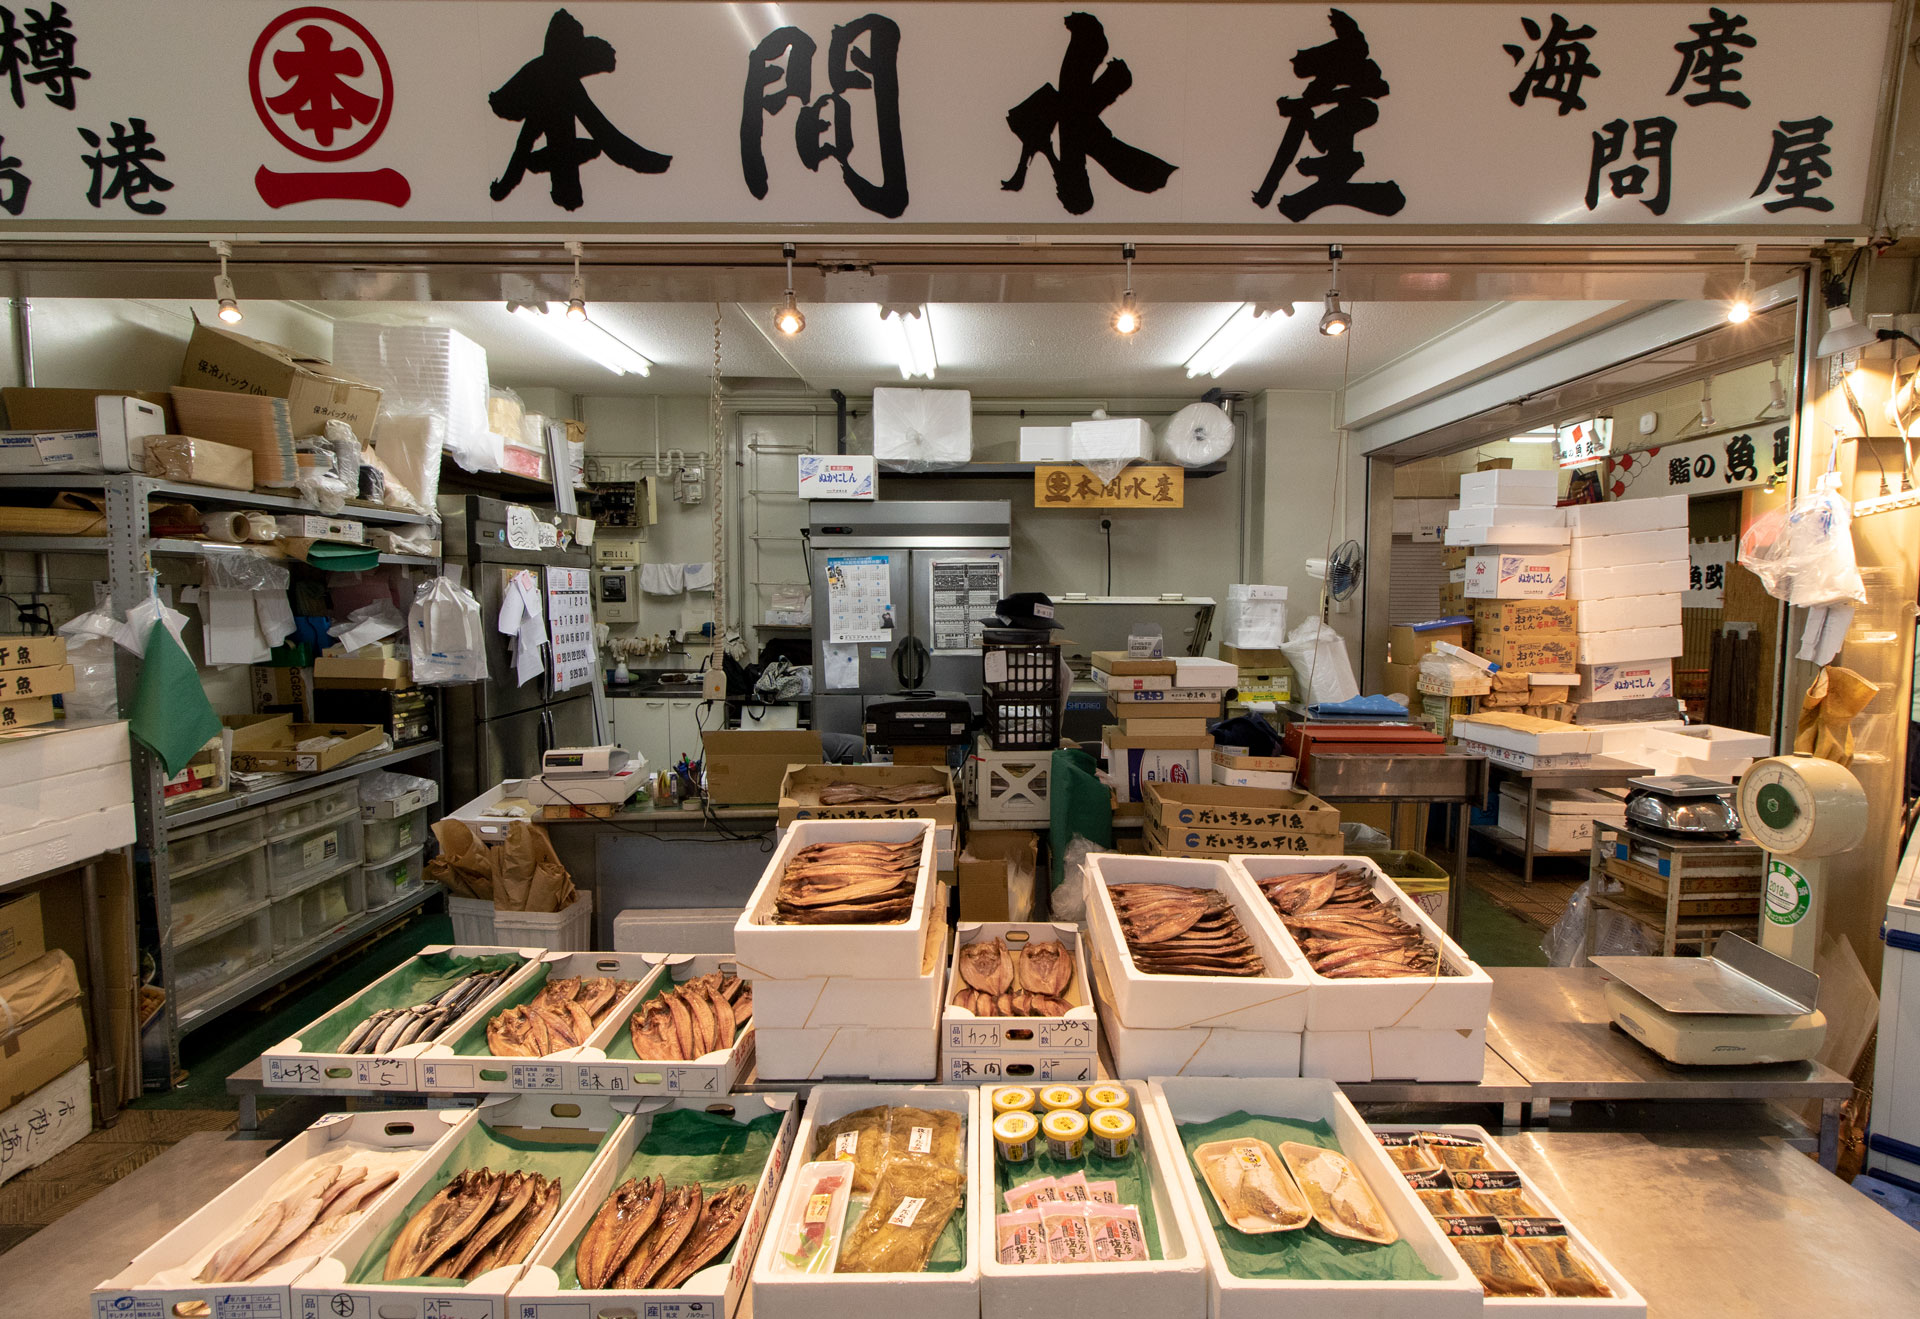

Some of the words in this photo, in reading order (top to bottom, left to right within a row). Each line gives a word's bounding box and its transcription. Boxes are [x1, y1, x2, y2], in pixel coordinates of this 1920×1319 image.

[488, 8, 1406, 222] 本間水産
[1585, 116, 1834, 215] 問屋
[818, 473, 857, 483] ぬかにしん
[1518, 573, 1553, 583] ぬかにしん
[1515, 613, 1543, 624] おから
[1515, 623, 1535, 631] にしん
[1517, 650, 1544, 661] おから
[1517, 660, 1536, 668] にしん
[1614, 677, 1655, 690] ぬかにしん
